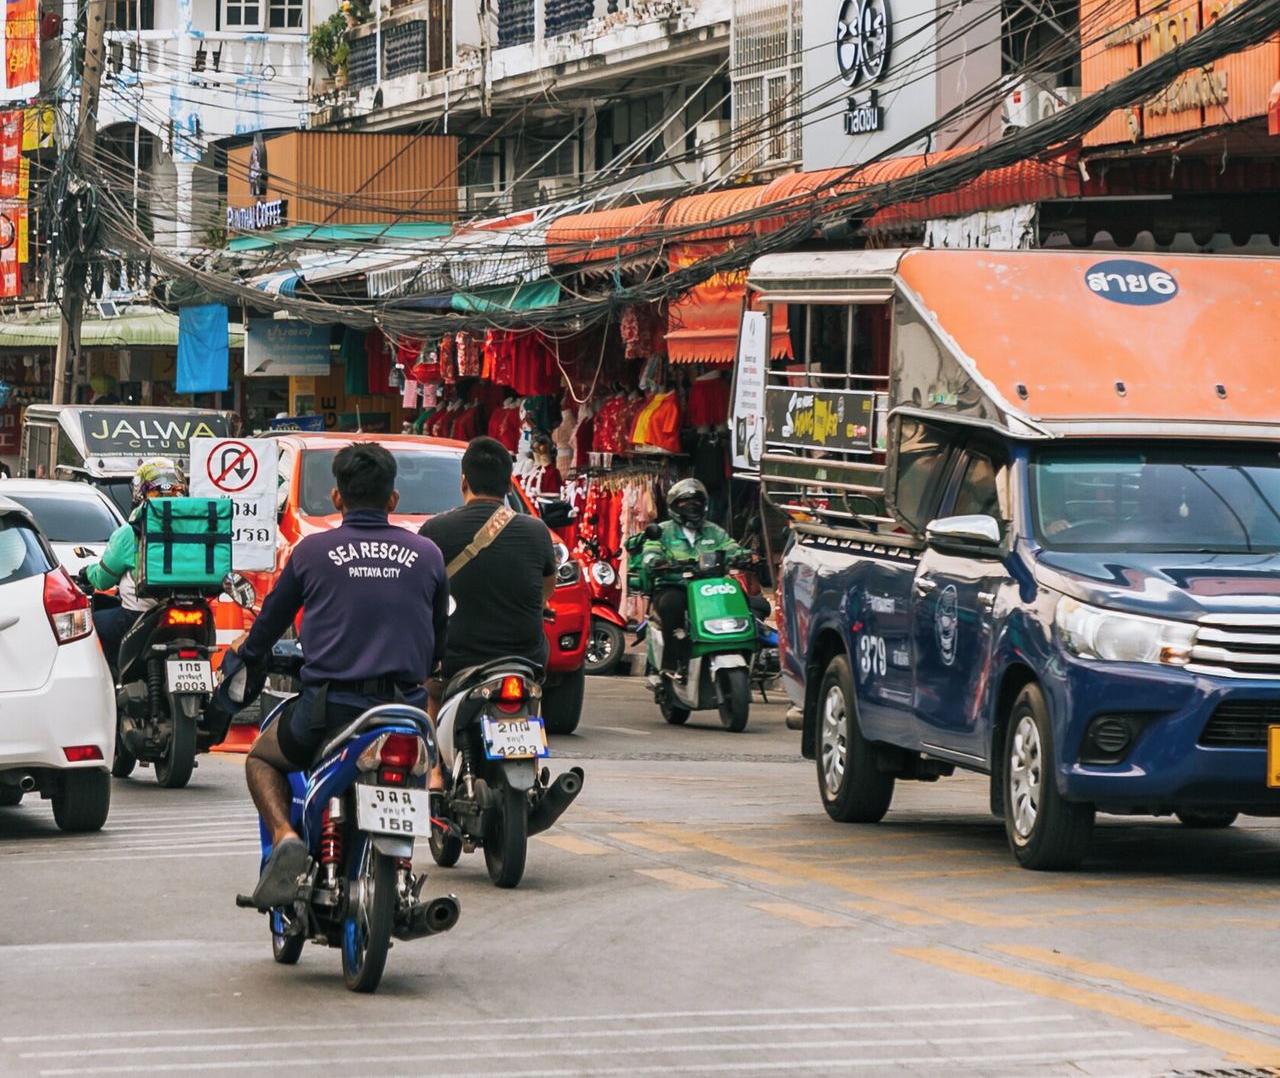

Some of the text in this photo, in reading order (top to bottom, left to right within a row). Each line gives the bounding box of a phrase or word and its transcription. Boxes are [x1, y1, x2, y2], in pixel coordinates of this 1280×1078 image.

[256, 200, 282, 227] COFFEE
[1087, 272, 1176, 294] สาย6
[92, 419, 217, 440] JALWA
[129, 439, 185, 449] CLUB
[328, 542, 419, 568] SEA RESCUE
[349, 567, 400, 578] PATTAYA CITY
[700, 583, 737, 596] Grab
[861, 635, 887, 676] 379
[175, 682, 207, 691] 9003
[497, 745, 538, 757] 4293
[379, 817, 413, 832] 158
